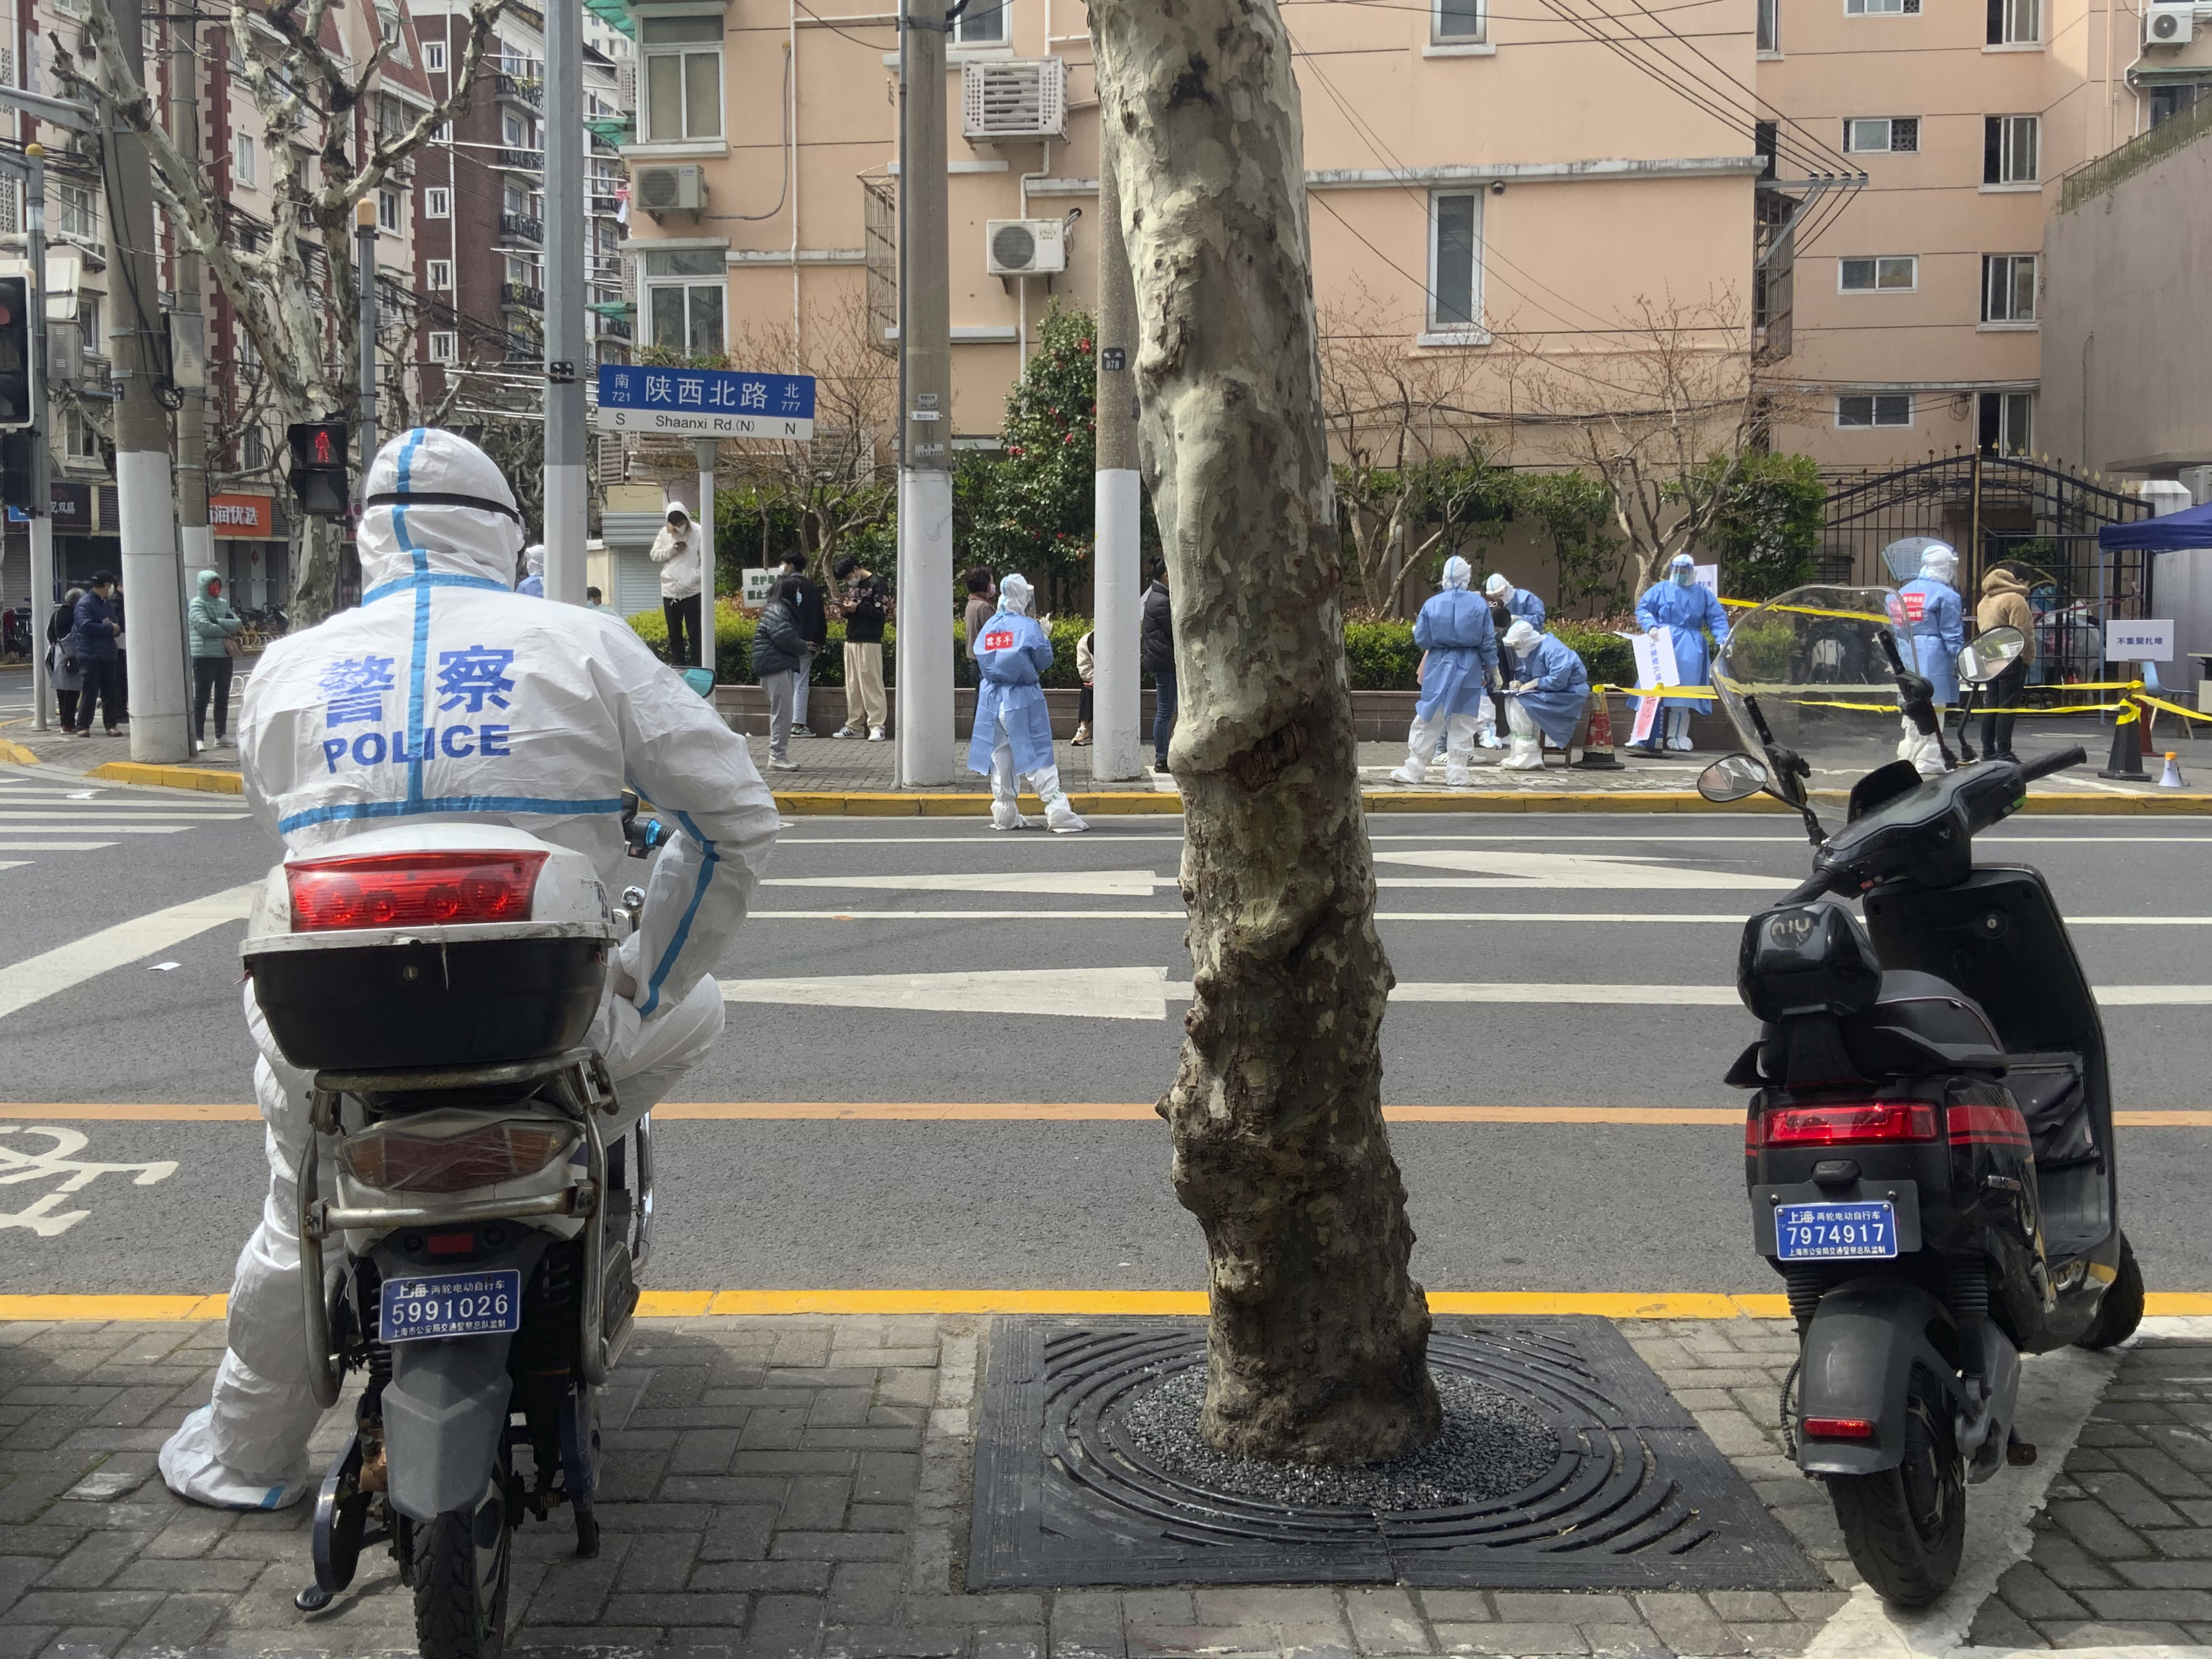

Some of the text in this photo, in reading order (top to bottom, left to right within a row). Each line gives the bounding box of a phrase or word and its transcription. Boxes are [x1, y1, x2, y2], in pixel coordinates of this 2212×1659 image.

[615, 373, 629, 388] 南
[612, 392, 630, 402] 721
[646, 375, 768, 409] 陕西北路
[784, 383, 799, 399] 北
[781, 401, 801, 411] 777
[616, 413, 625, 425] S
[656, 415, 755, 432] Shaanxi Rd.(N)
[785, 422, 796, 435] N
[2117, 637, 2163, 645] 不集聚扎堆
[318, 645, 516, 728] 警察
[323, 724, 510, 774] POLICE
[1788, 1211, 1881, 1224] 上海 两轮电动自行车
[1786, 1223, 1884, 1245] 7974917
[1789, 1245, 1886, 1257] 上海市公安局交通警察总队监制
[395, 1280, 506, 1300] 上海 两轮电动自行车
[392, 1294, 508, 1325] 5991026
[393, 1319, 506, 1338] 上海市公安局交通警察总队监制
